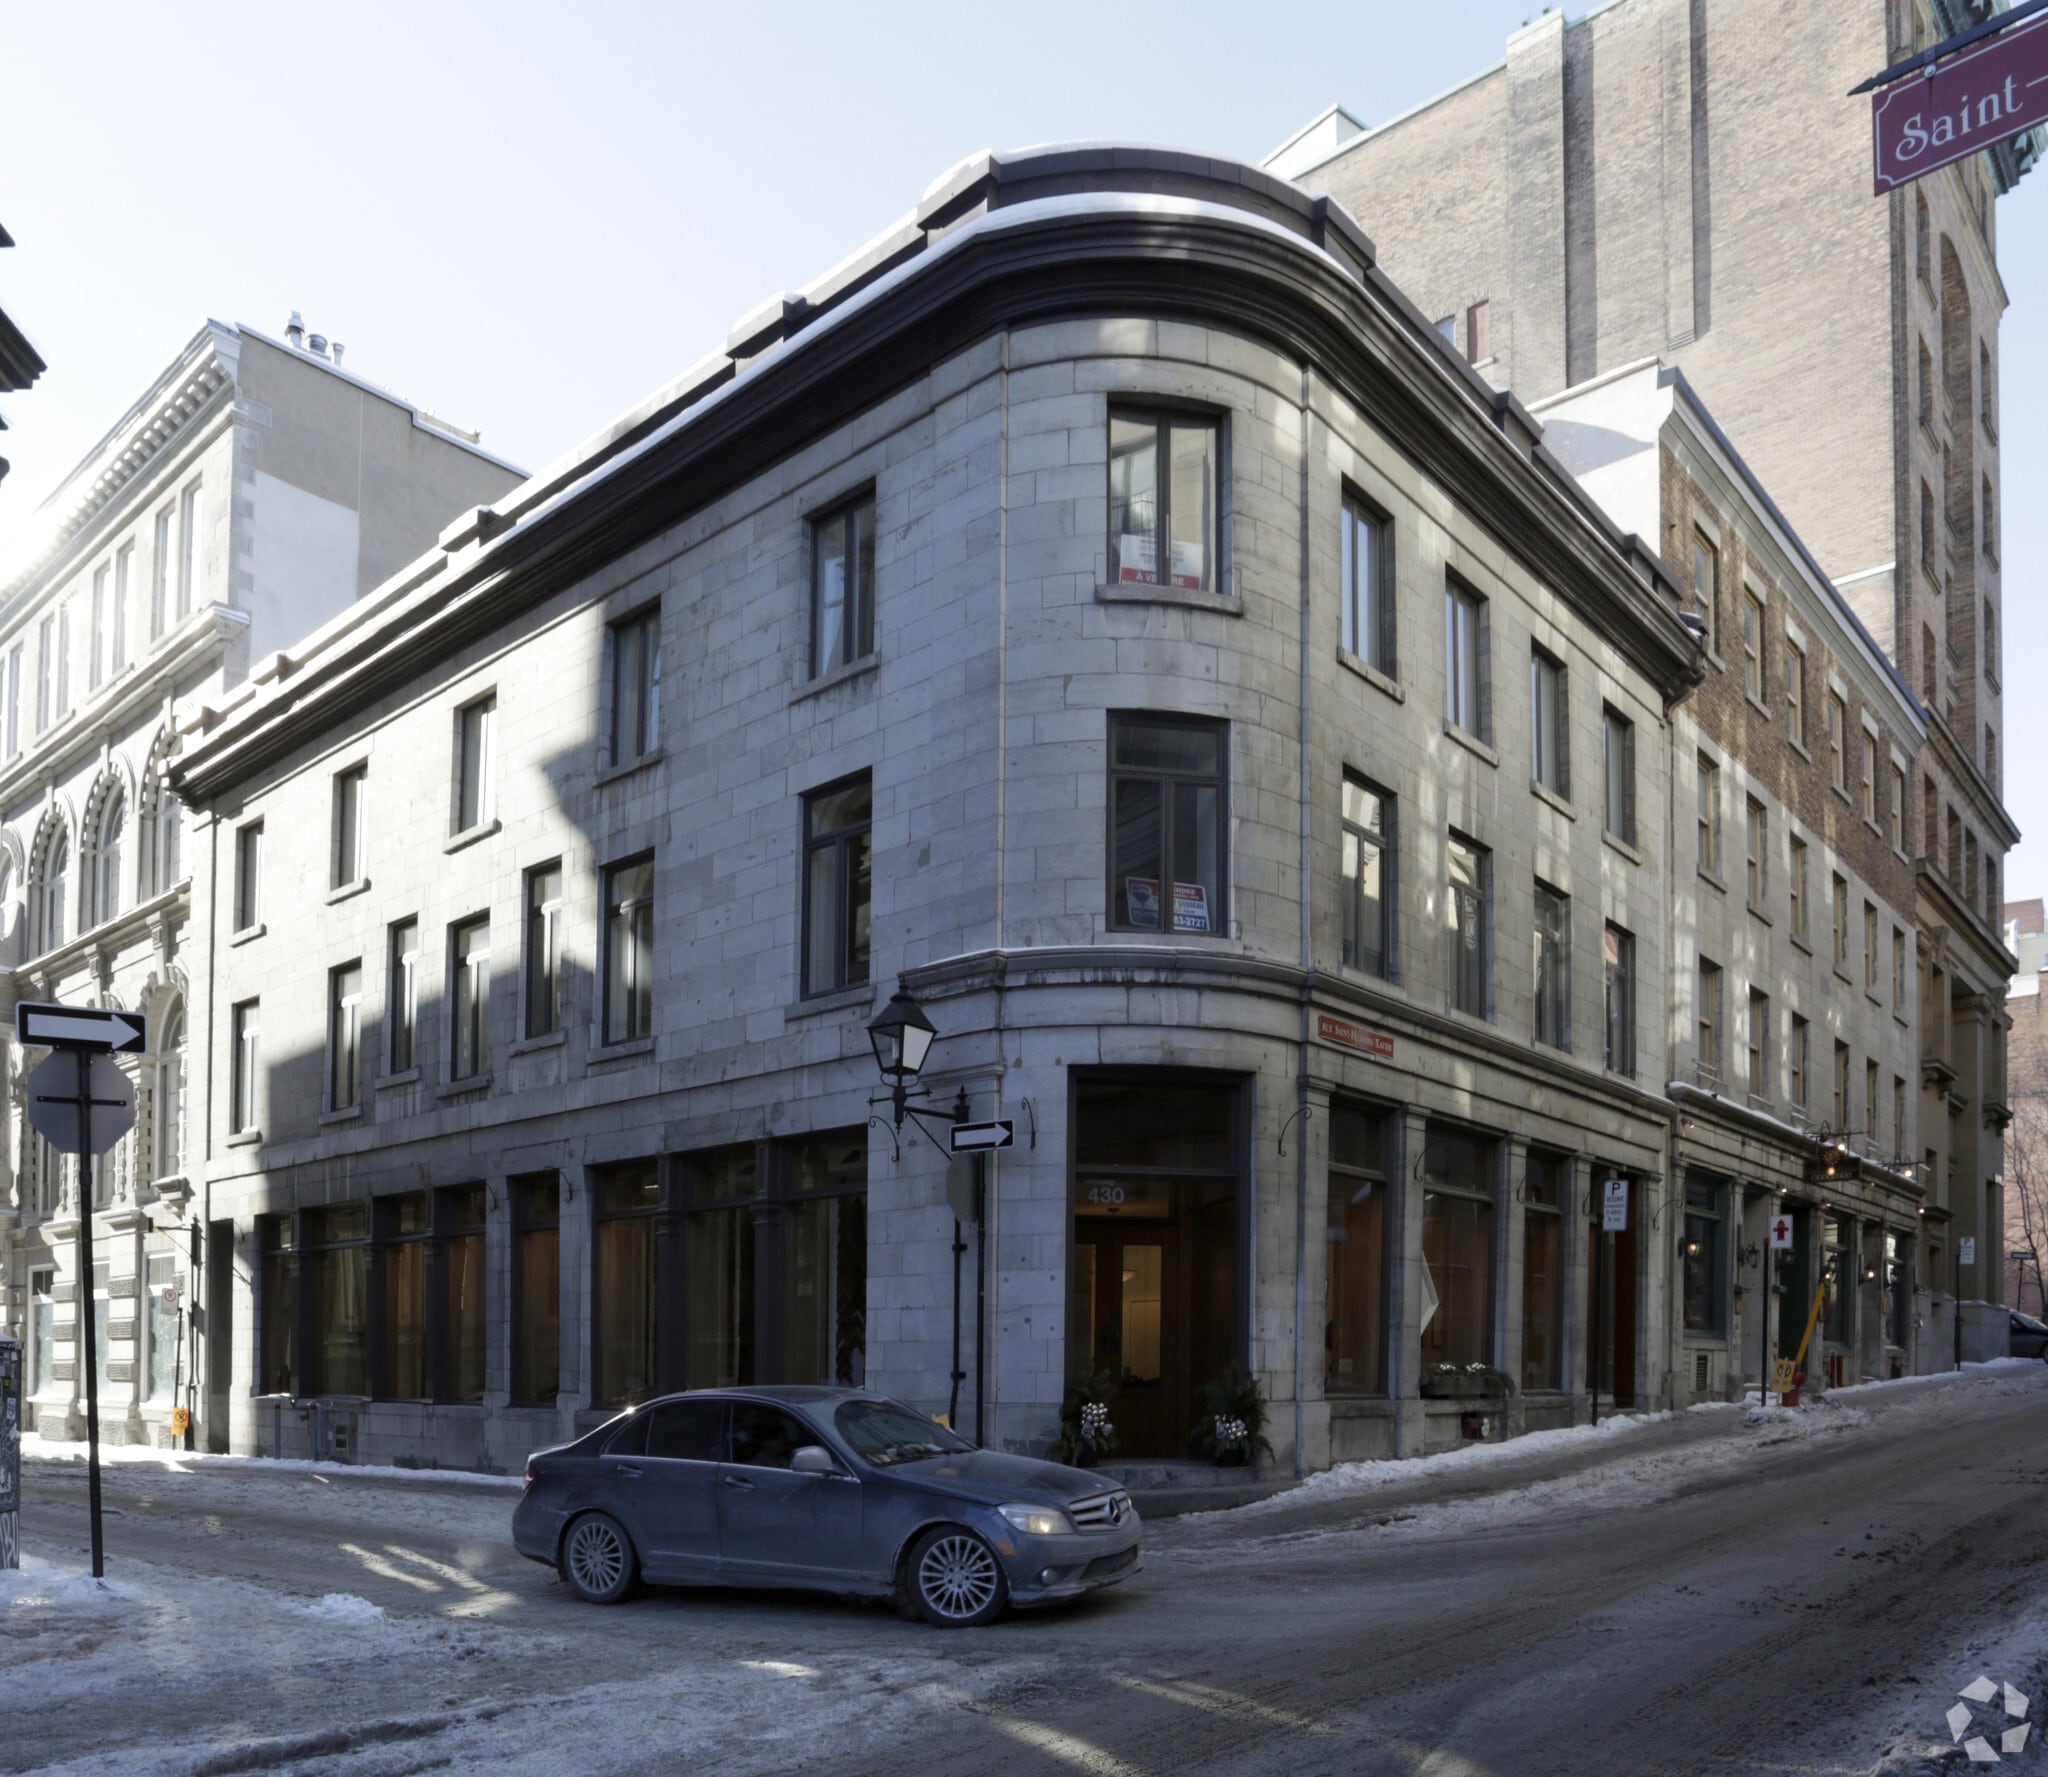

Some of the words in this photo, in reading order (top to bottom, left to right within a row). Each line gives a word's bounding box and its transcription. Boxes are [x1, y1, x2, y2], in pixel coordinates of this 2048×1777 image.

[1145, 573, 1185, 586] VERE
[1088, 1186, 1124, 1204] 430
[1612, 1182, 1621, 1196] P
